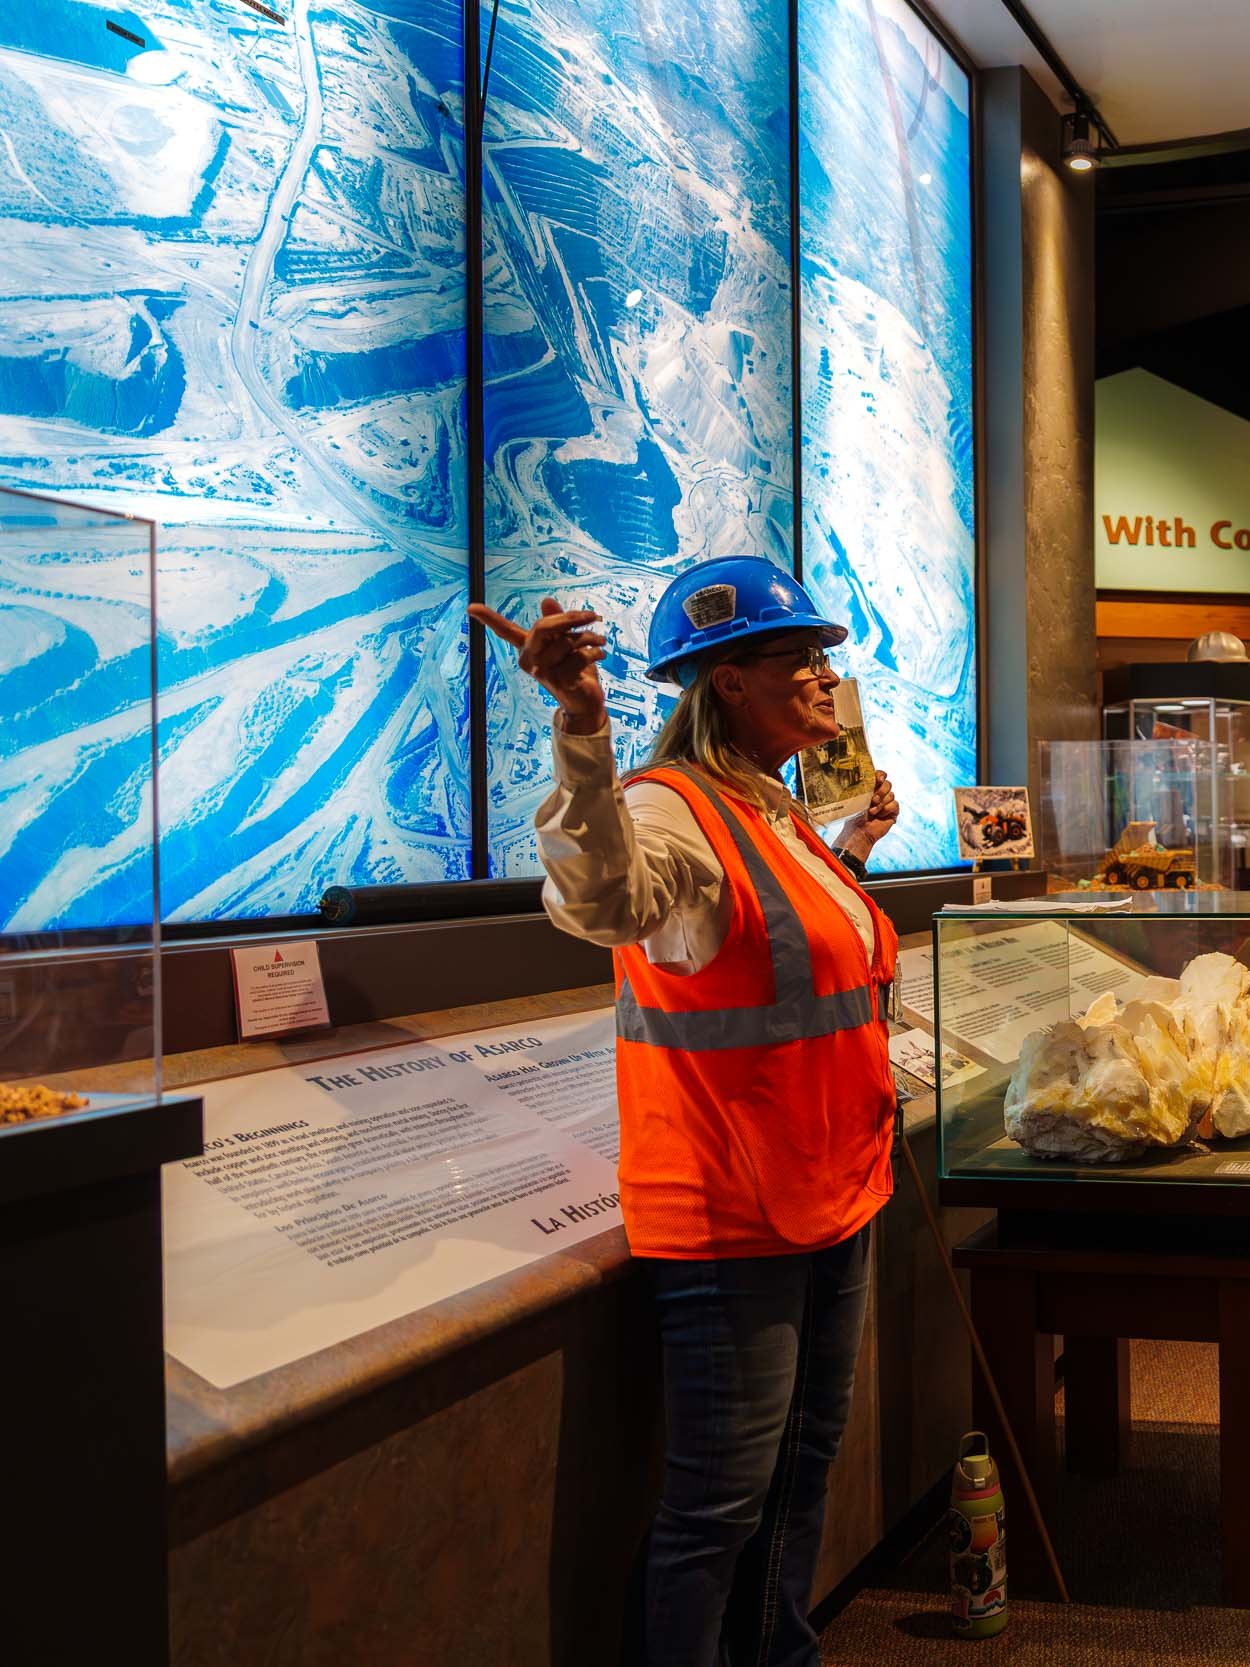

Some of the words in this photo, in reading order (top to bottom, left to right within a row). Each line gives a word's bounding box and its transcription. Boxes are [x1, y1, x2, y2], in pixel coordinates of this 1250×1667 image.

[1102, 515, 1196, 547] With
[252, 964, 270, 972] CHILD
[271, 960, 305, 970] SUPERVISION
[267, 969, 295, 978] REQUIRED
[305, 1074, 363, 1092] THE
[356, 1056, 447, 1082] HISTORY
[448, 1049, 475, 1063] OF
[474, 1037, 543, 1058] ASARCO
[204, 1137, 236, 1151] CO'S
[233, 1120, 310, 1142] BEGINNINGS
[531, 1216, 567, 1236] LA
